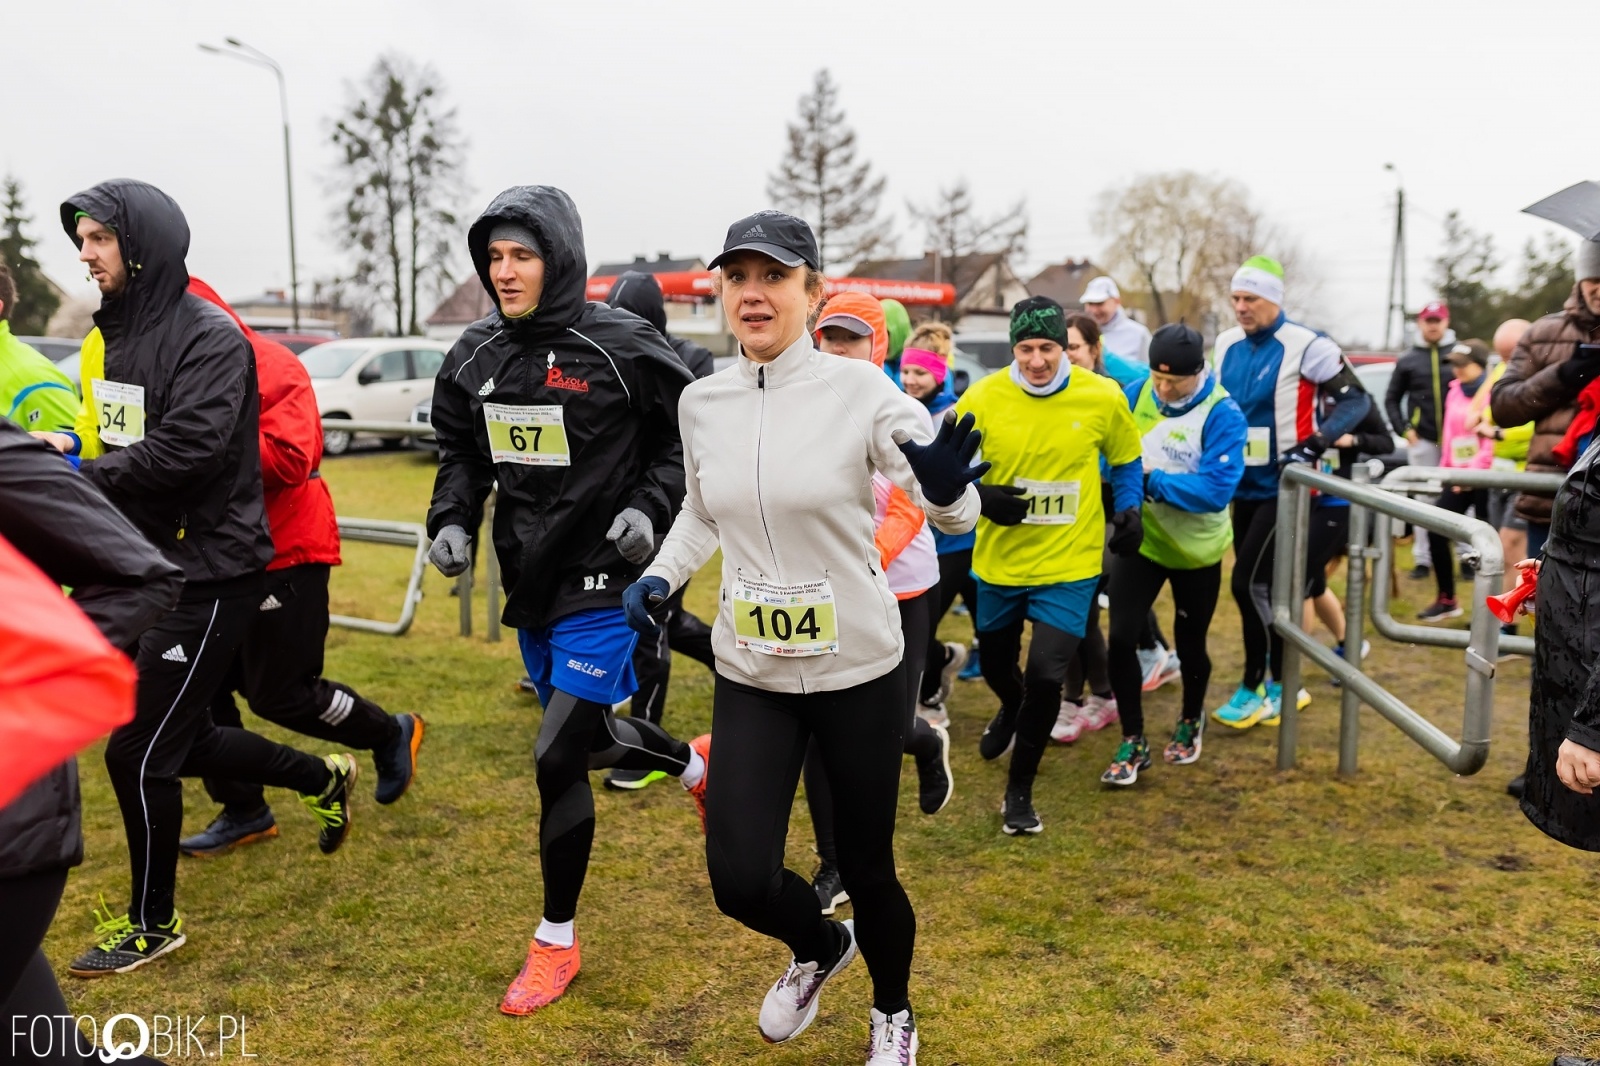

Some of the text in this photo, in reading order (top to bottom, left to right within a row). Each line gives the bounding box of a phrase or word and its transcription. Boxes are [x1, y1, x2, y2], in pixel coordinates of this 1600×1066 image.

[742, 231, 767, 239] adidas
[103, 403, 126, 431] 54
[509, 425, 543, 452] 67
[1029, 495, 1064, 514] 111
[749, 606, 821, 641] 104
